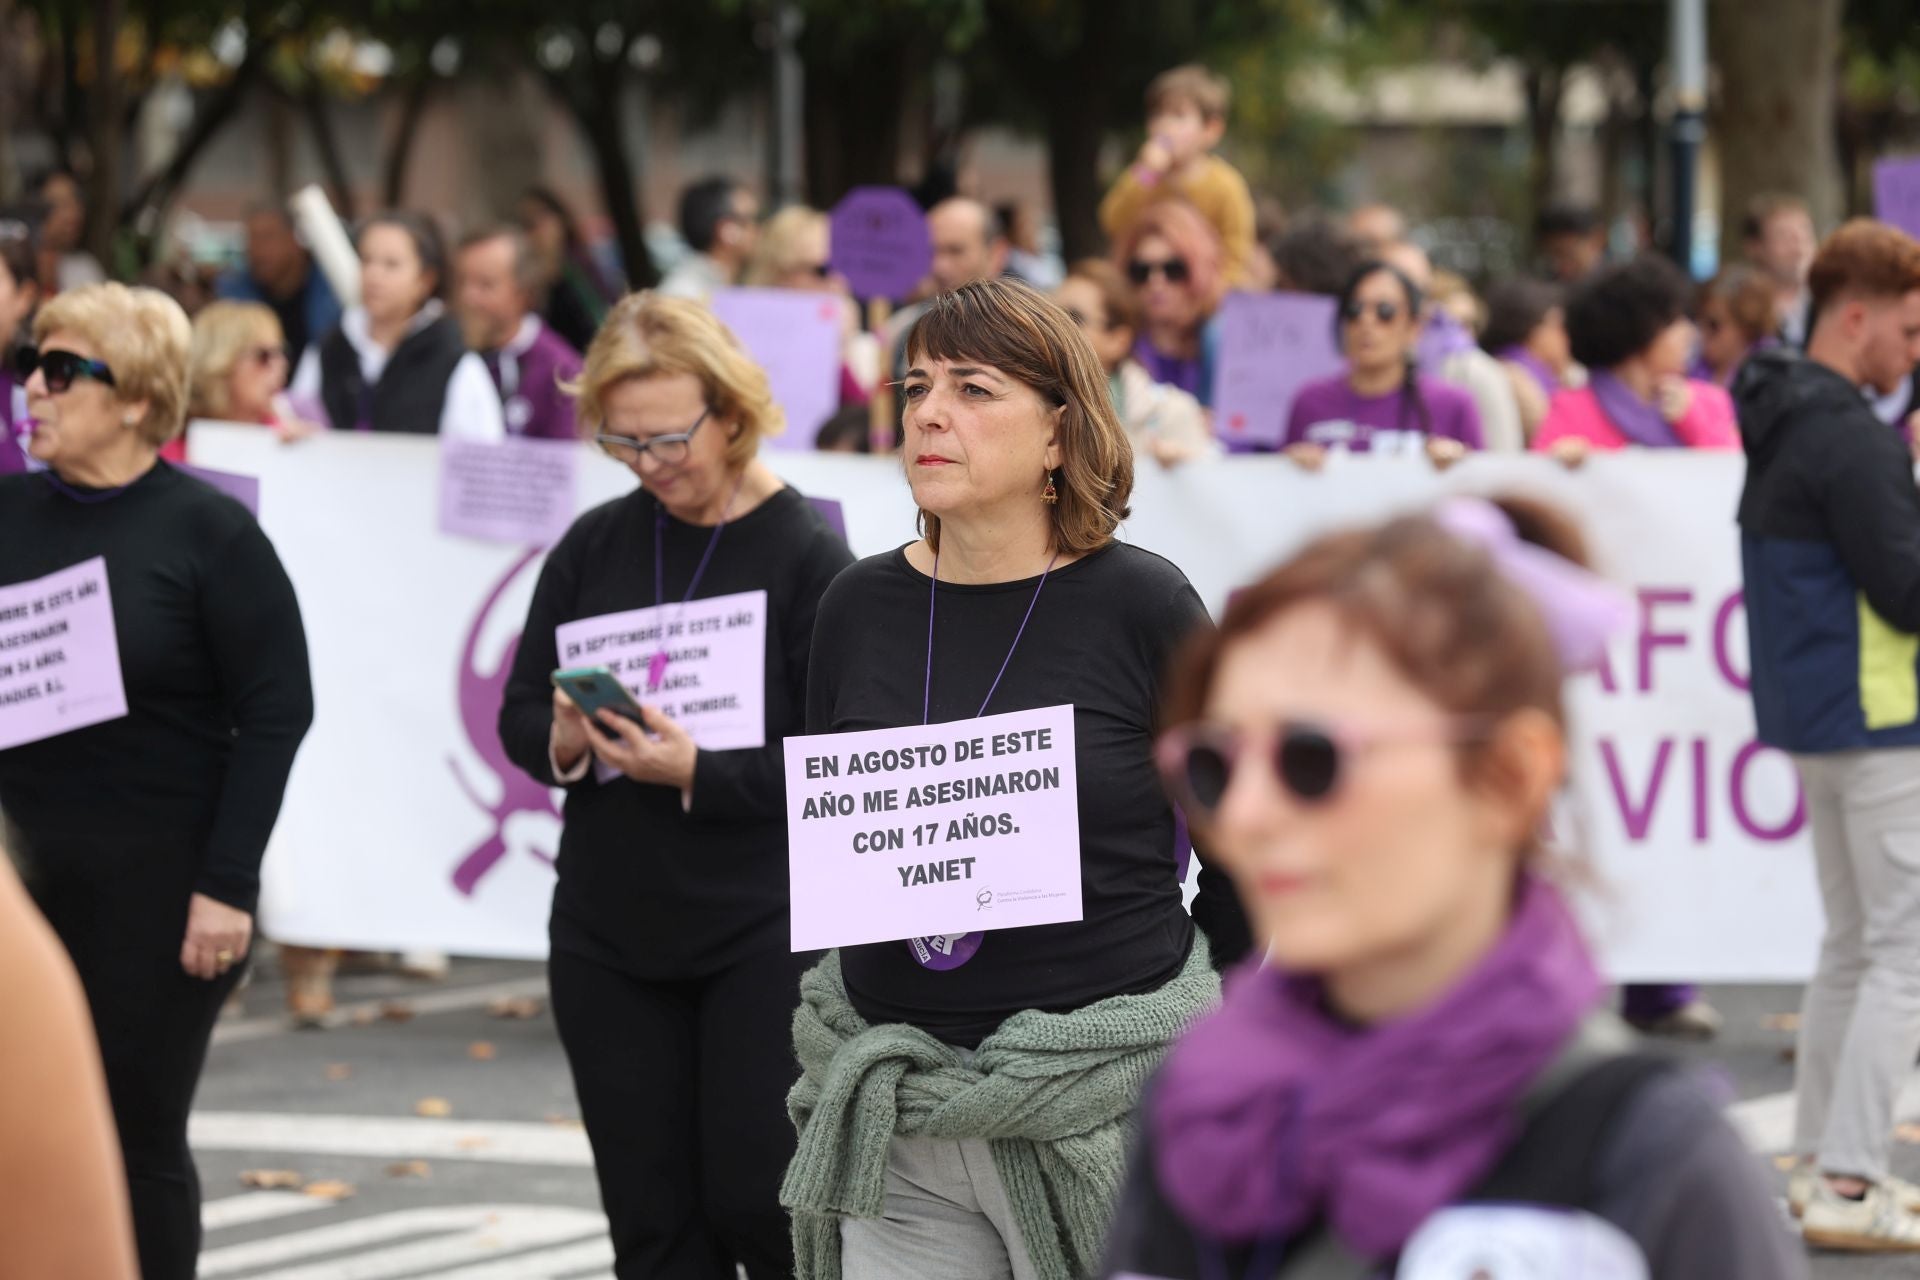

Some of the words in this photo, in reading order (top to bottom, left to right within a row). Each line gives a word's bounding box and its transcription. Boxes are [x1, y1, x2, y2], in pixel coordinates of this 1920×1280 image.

[566, 642, 581, 658] EN
[586, 627, 663, 653] SEPTIEMBRE
[668, 623, 683, 638] DE
[689, 616, 721, 634] ESTE
[725, 611, 754, 628] AÑO
[663, 674, 702, 691] AÑOS.
[681, 696, 742, 715] NOMBRE.
[805, 755, 839, 779] EN
[847, 744, 947, 776] AGOSTO
[954, 738, 984, 763] DE
[992, 728, 1052, 756] ESTE
[802, 791, 855, 820] AÑO
[863, 789, 898, 814] ME
[905, 767, 1060, 809] ASESINARON
[853, 828, 904, 854] CON
[912, 823, 939, 847] 17
[946, 812, 1020, 842] AÑOS.
[898, 857, 976, 887] YANET
